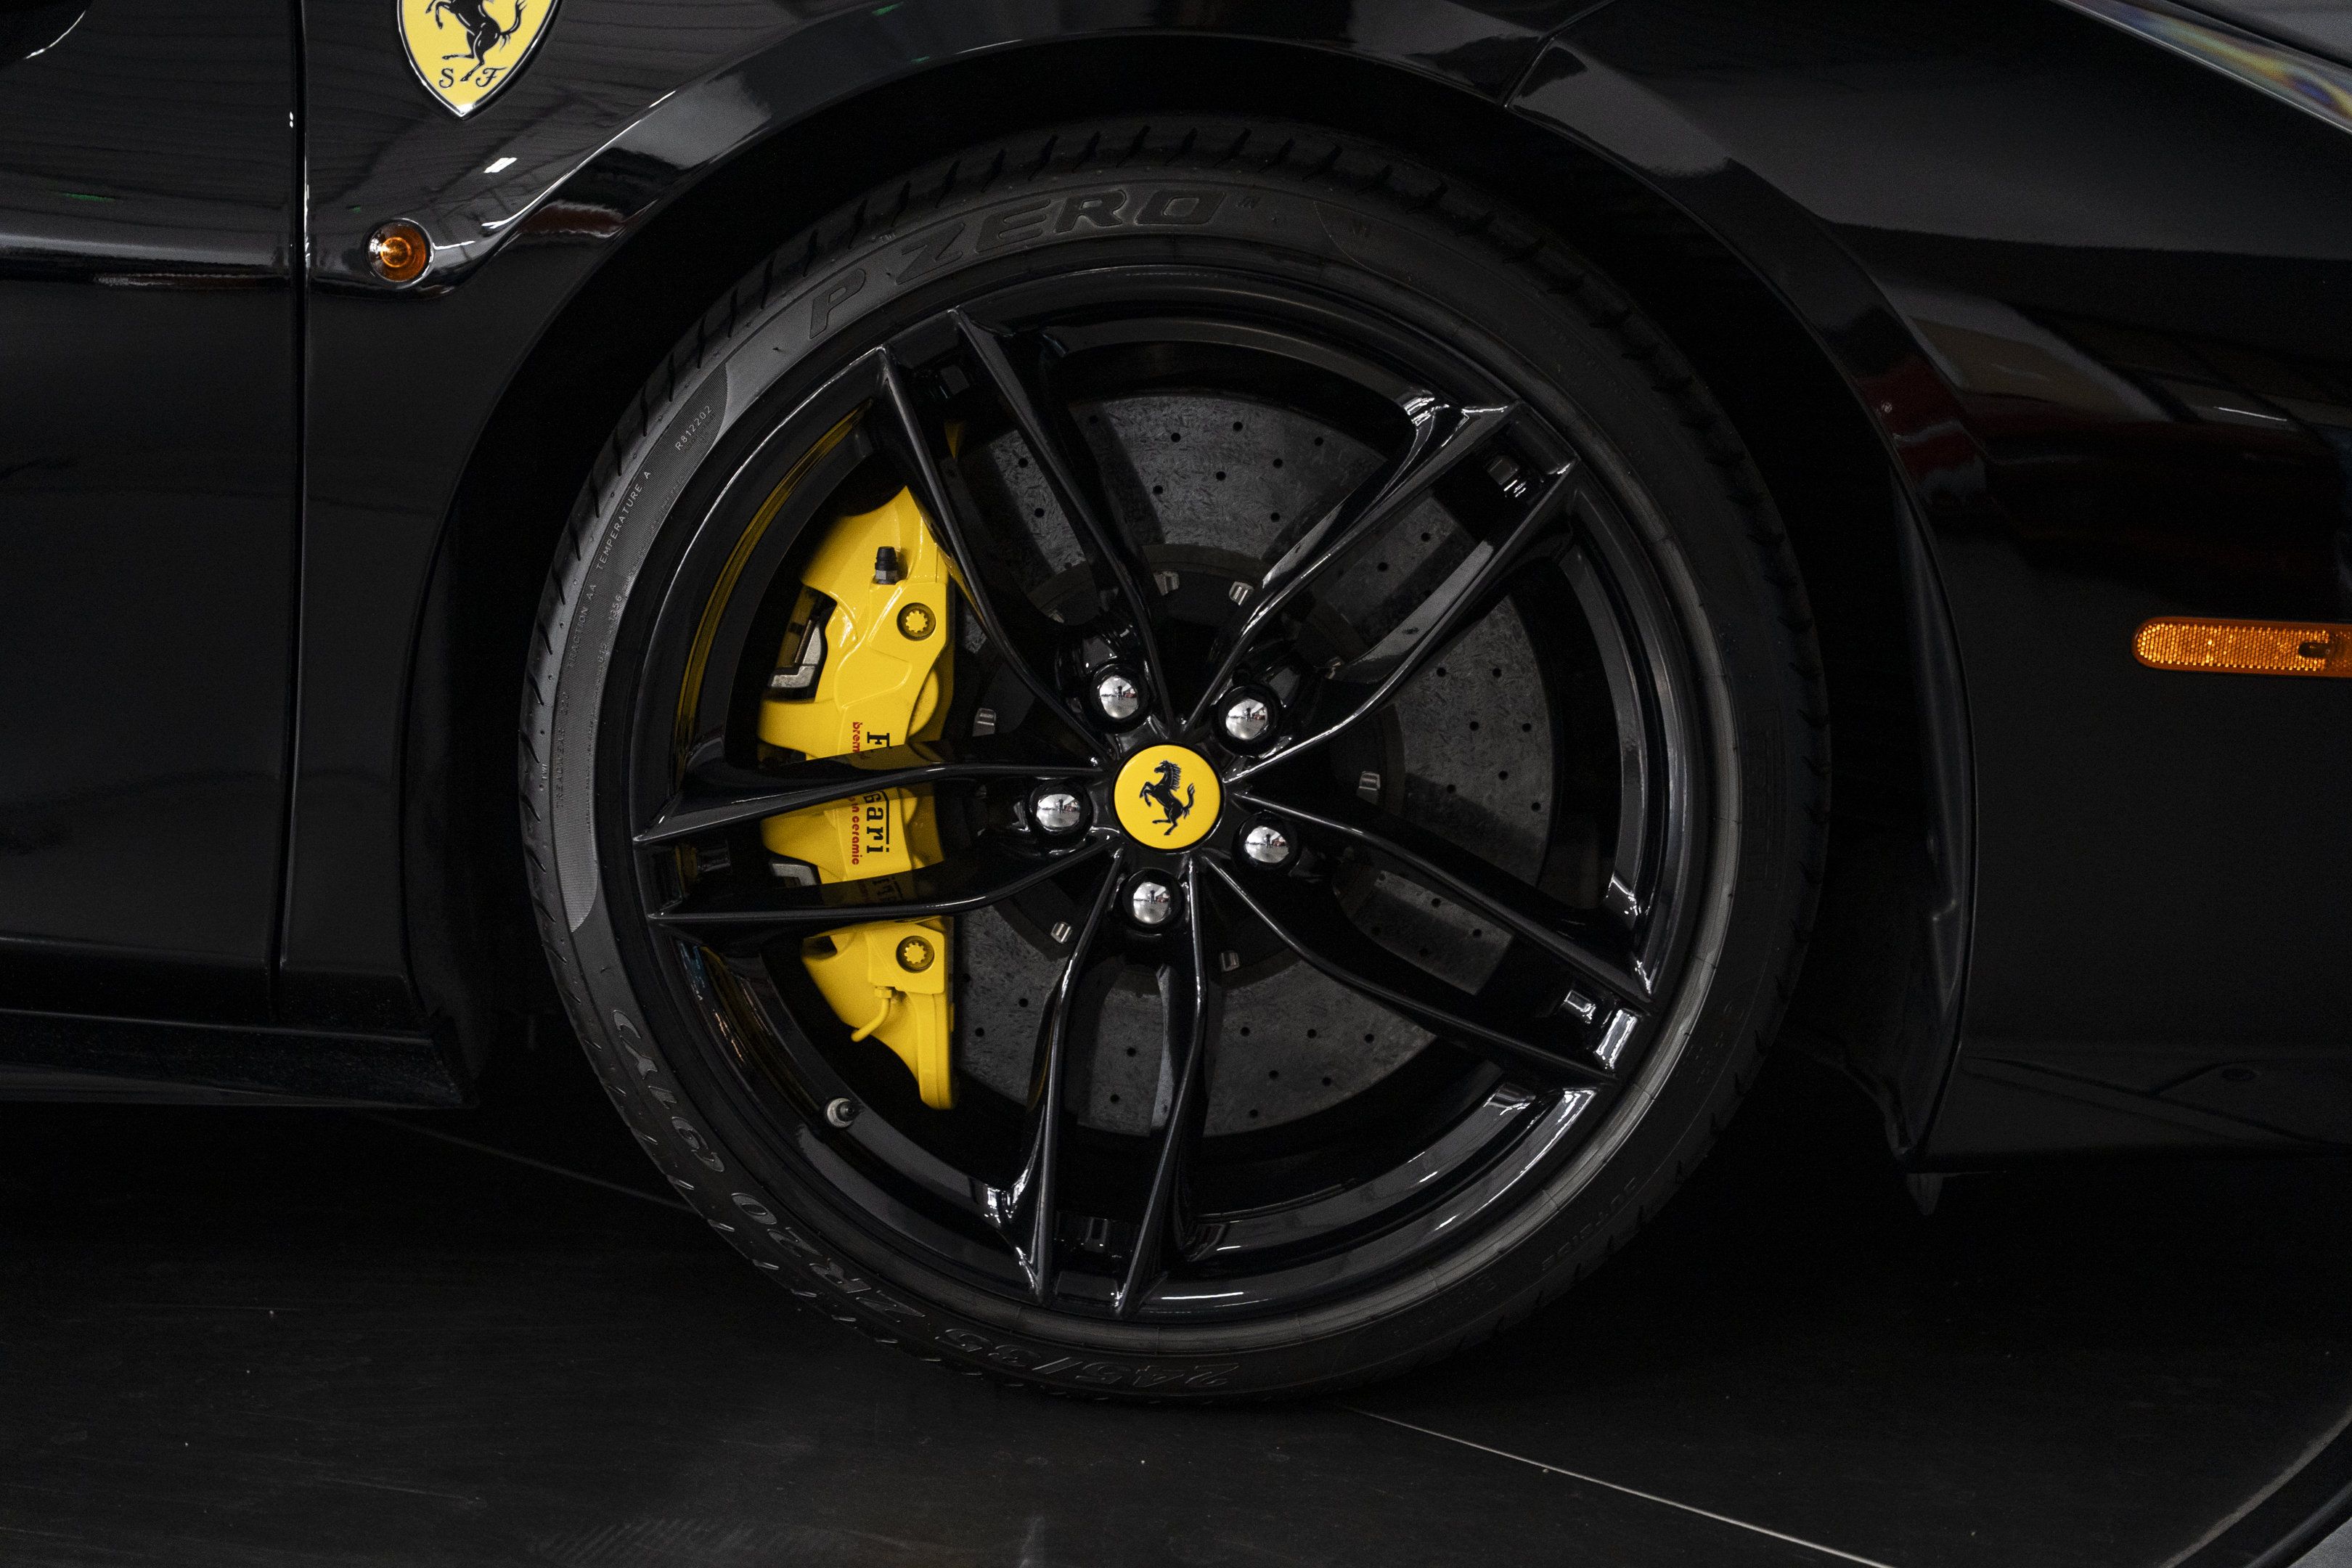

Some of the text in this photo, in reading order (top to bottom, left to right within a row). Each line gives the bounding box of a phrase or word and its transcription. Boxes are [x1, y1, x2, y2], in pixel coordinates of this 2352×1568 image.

[439, 67, 507, 88] S F
[809, 268, 867, 339] P
[895, 189, 1227, 285] ZERO
[674, 405, 713, 451] R812202
[556, 727, 565, 808] TREADWEAR
[567, 606, 590, 669] TRACTION
[586, 584, 597, 602] AA
[596, 484, 643, 570] TEMPERATURE
[642, 470, 652, 480] A
[852, 815, 862, 865] ceramic
[613, 1009, 1239, 1387] 245/35 ZR20 (91Y)
